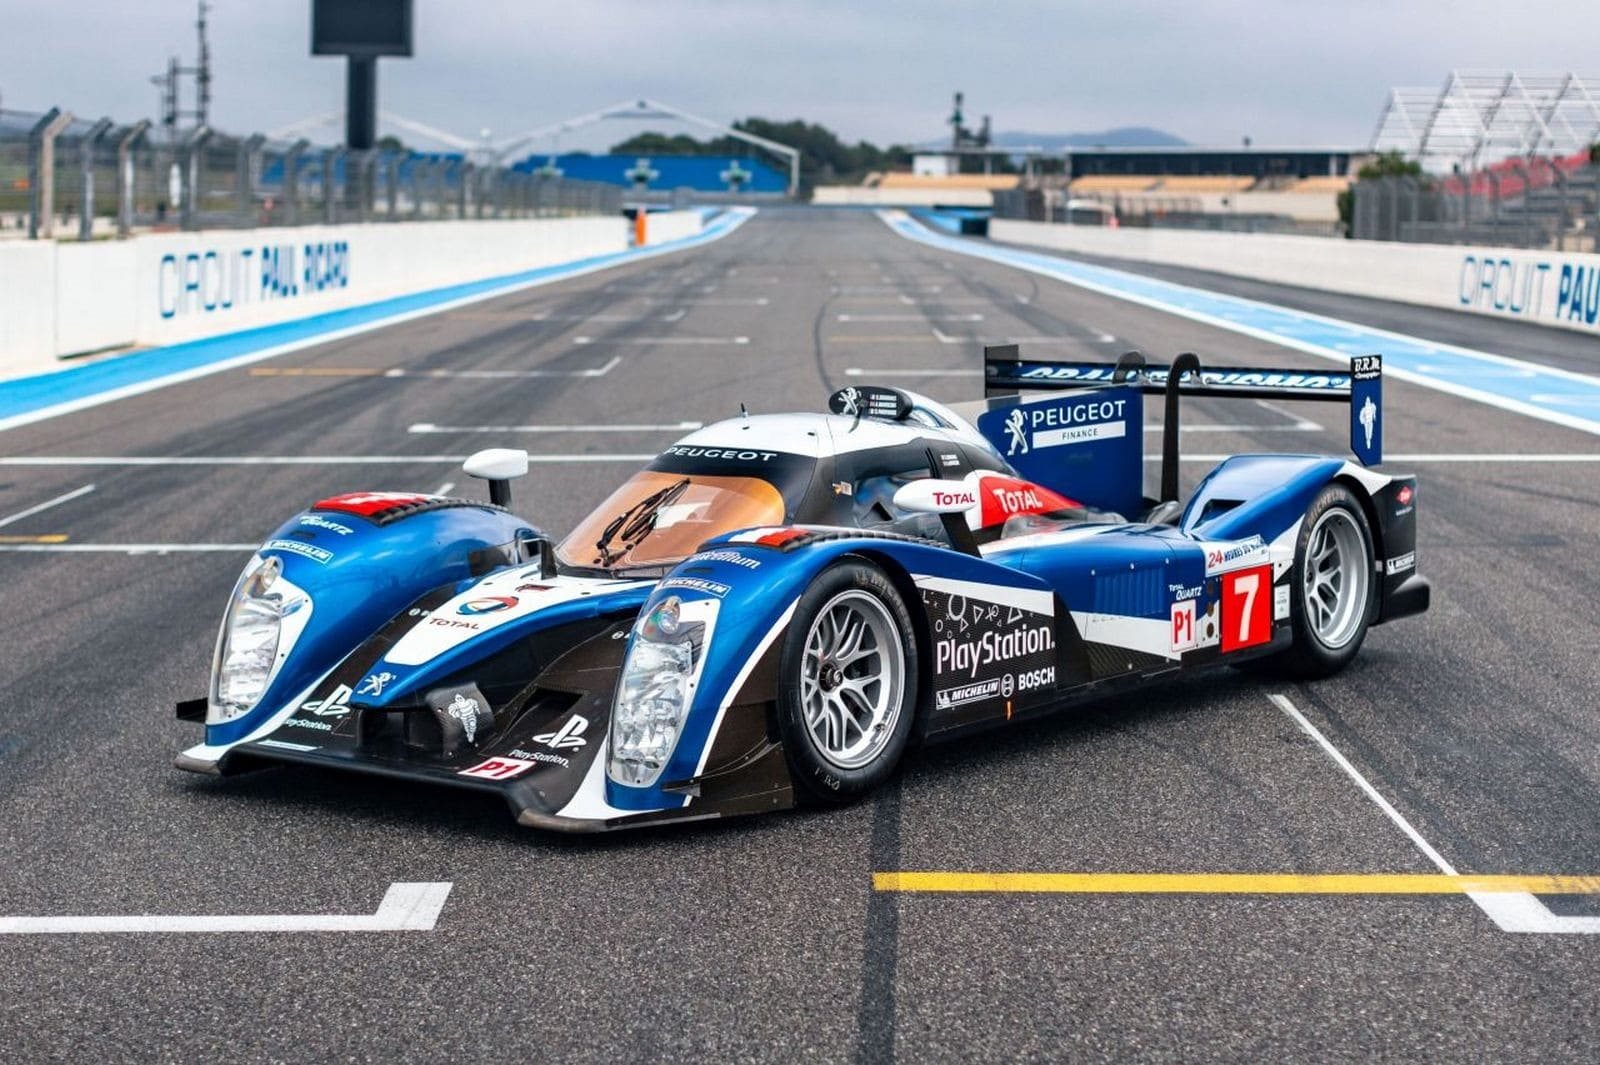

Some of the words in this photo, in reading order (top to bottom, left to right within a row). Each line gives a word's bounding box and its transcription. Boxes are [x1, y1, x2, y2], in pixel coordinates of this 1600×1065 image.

[160, 249, 254, 320] CIRCUIT
[260, 246, 297, 301] PAUL
[305, 241, 348, 294] RICARD
[1461, 256, 1551, 316] CIRCUIT
[1032, 400, 1126, 428] PEUGEOT
[1062, 428, 1098, 440] FINANCE
[664, 447, 777, 461] PEUGEOT
[932, 492, 975, 506] TOTAL
[992, 488, 1043, 513] TOTAL
[1208, 550, 1223, 568] 24
[664, 577, 727, 593] MICHELIN
[1234, 573, 1259, 642] 7
[429, 618, 480, 629] TOTAL
[1174, 609, 1191, 644] P1
[952, 681, 999, 701] MICHELIN
[1018, 666, 1055, 691] BOSCH
[469, 761, 519, 776] P1
